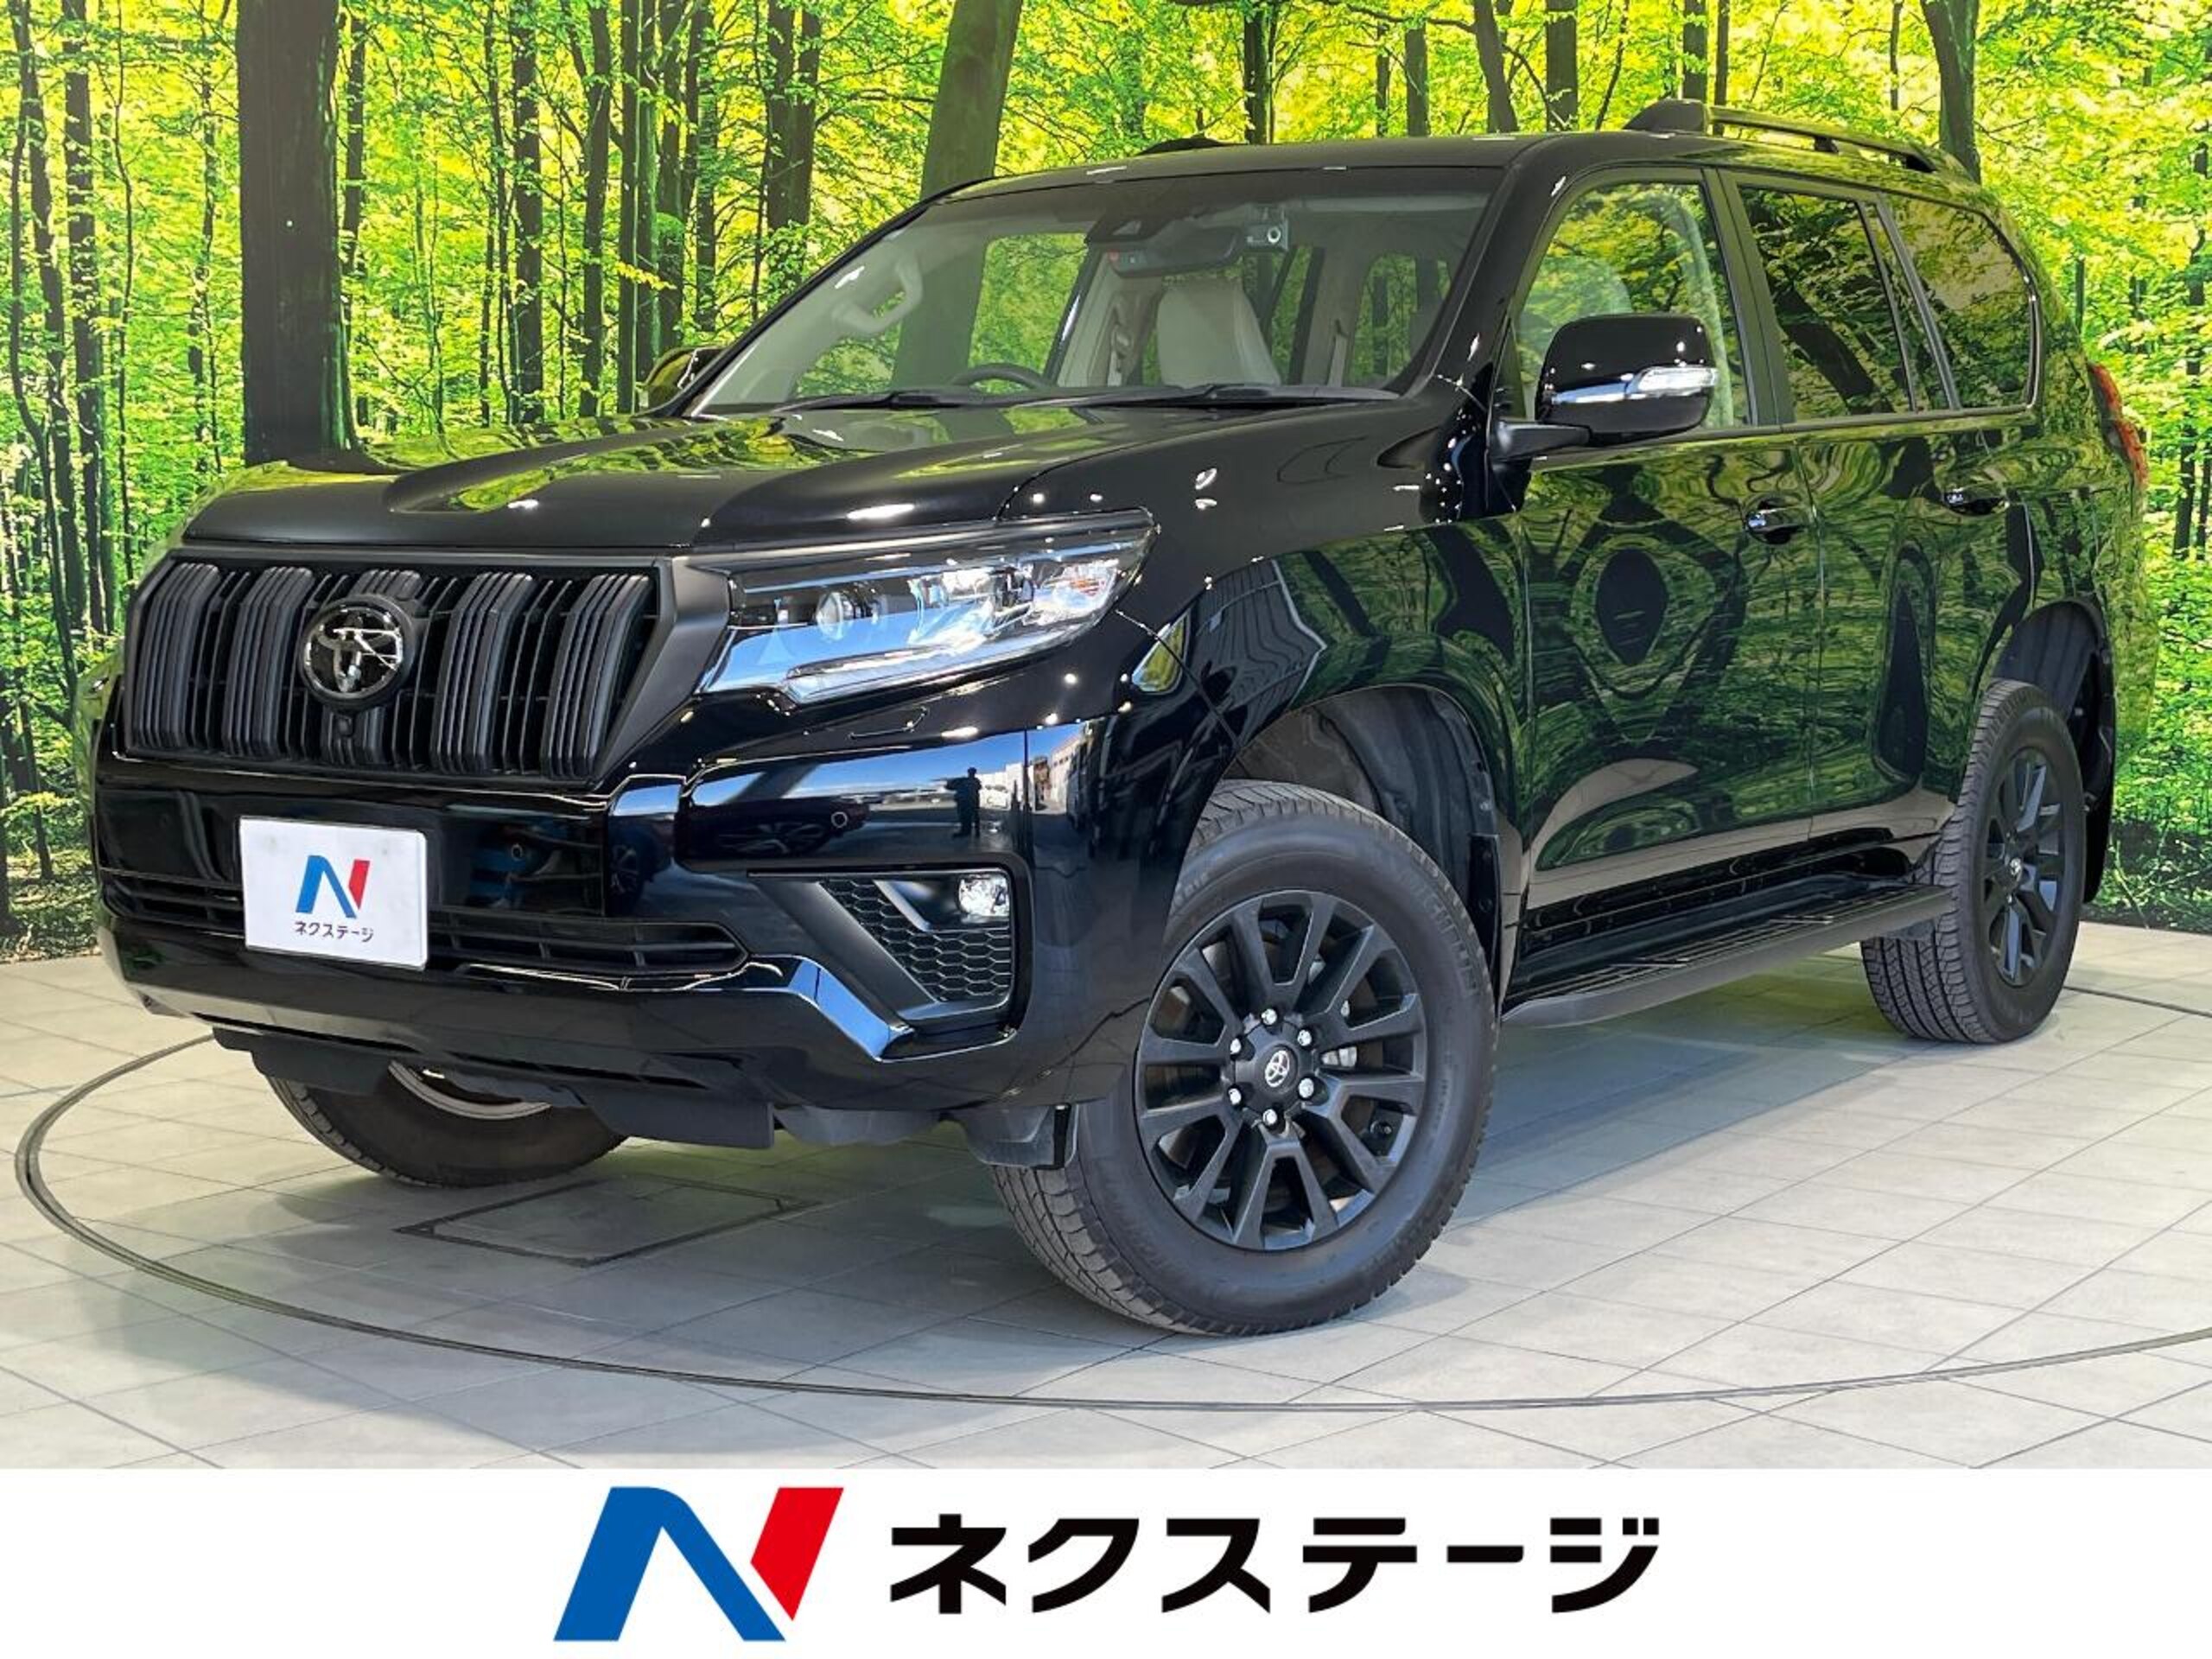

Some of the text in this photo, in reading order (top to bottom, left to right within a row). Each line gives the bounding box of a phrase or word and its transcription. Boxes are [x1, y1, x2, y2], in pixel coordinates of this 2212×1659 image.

[295, 920, 374, 943] ネクステージ
